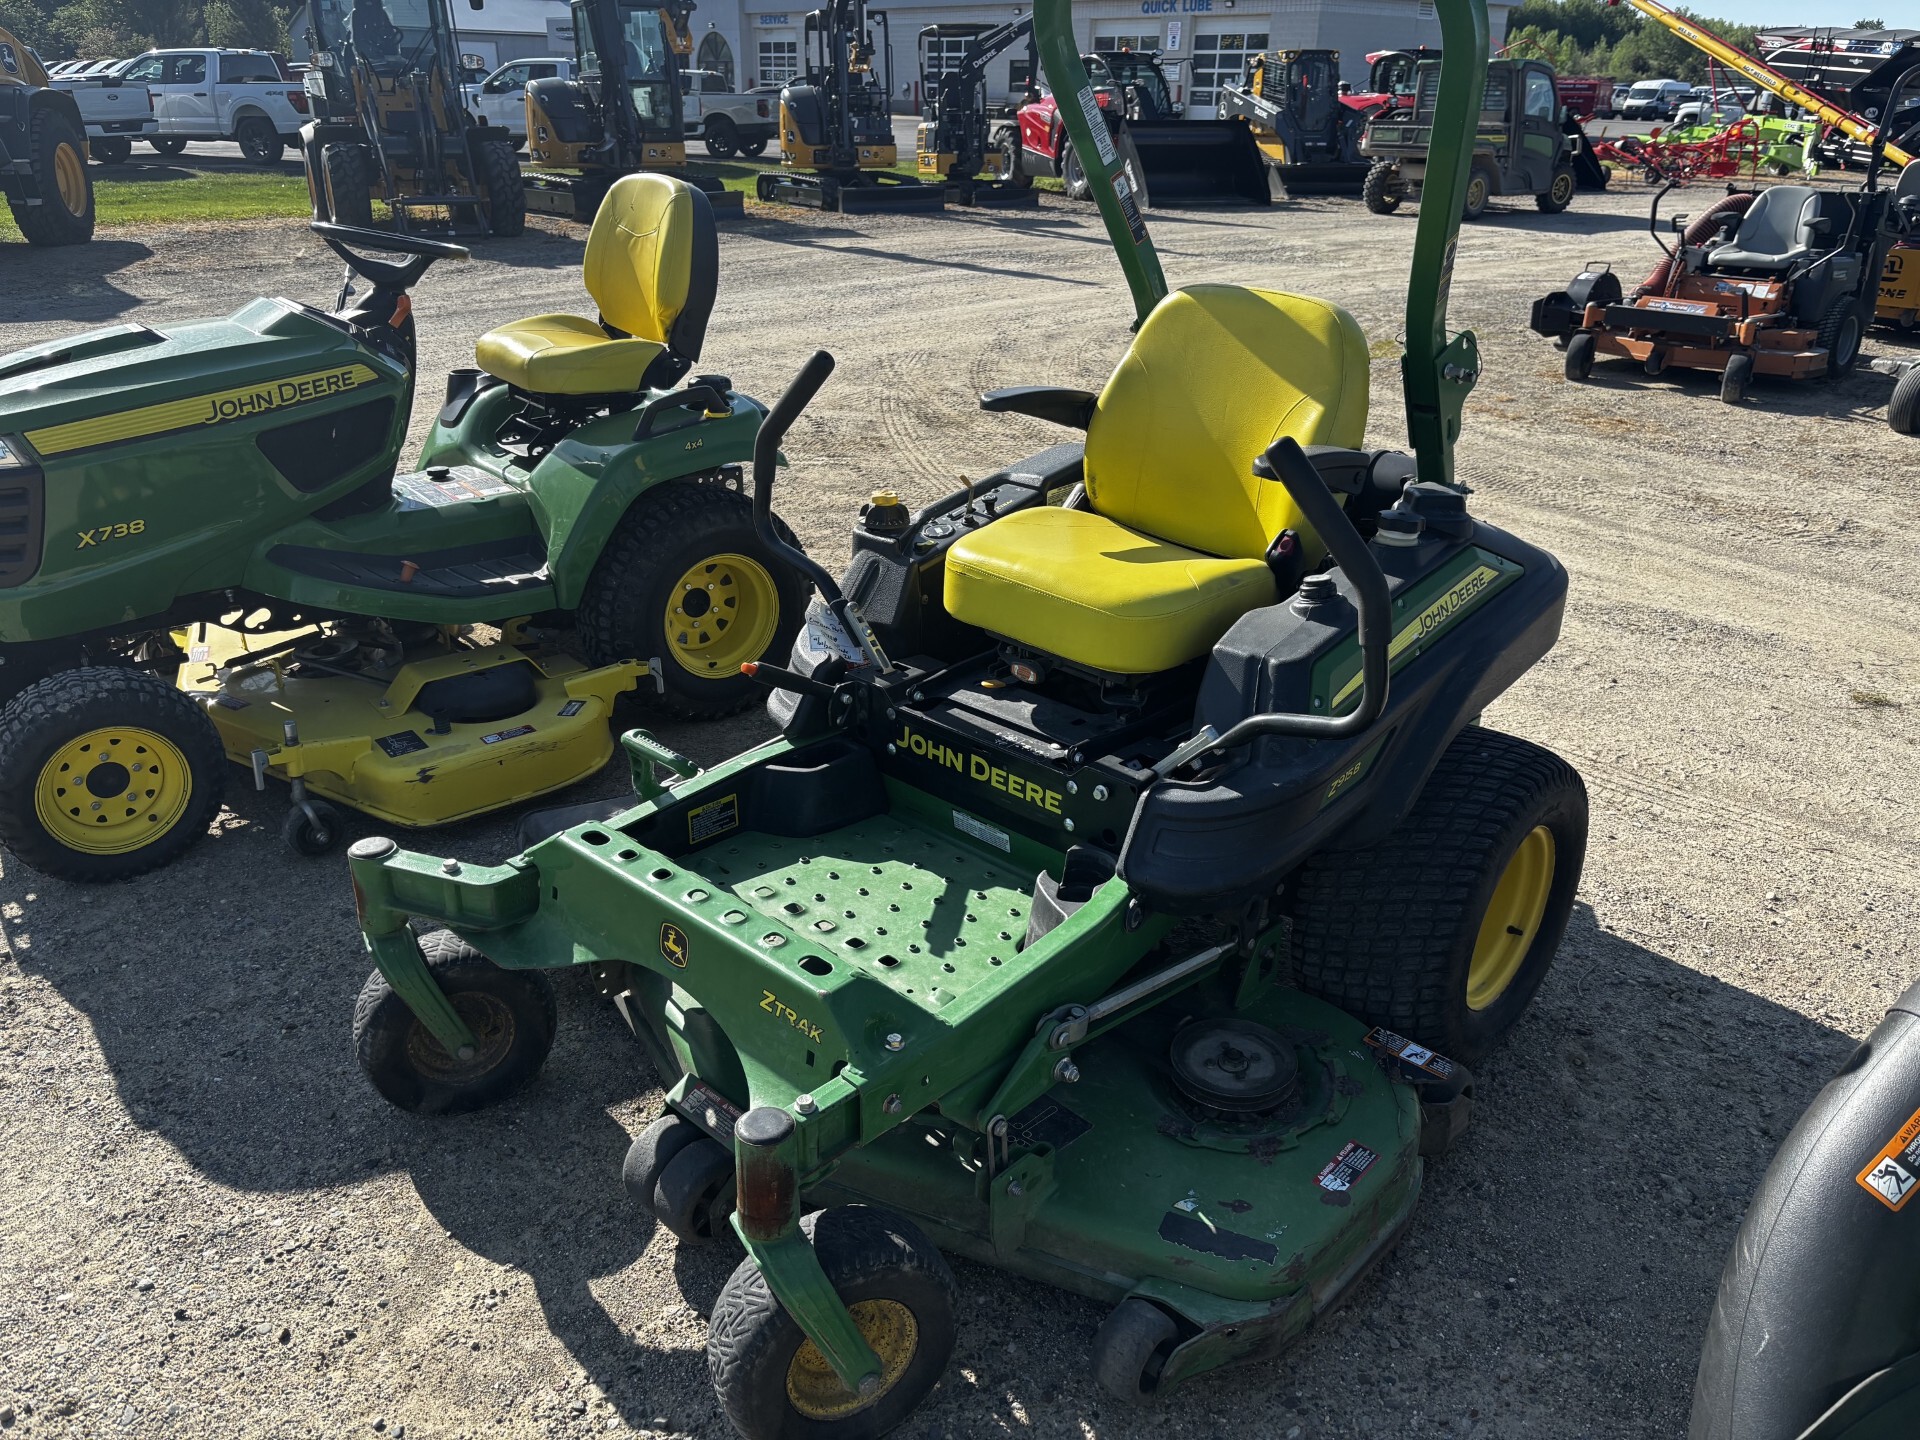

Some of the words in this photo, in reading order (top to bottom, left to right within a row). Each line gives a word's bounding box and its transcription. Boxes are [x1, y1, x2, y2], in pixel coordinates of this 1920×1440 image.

[760, 14, 788, 24] SERVICE
[1142, 0, 1177, 13] QUICK
[1183, 0, 1212, 12] LUBE
[973, 48, 997, 68] DEERE
[1753, 70, 1777, 86] WESTFIELD
[205, 389, 273, 423] JOHN
[278, 370, 356, 404] DEERE
[76, 519, 146, 550] X738
[1417, 600, 1449, 636] JOHN
[1450, 572, 1487, 609] DEERE
[896, 725, 963, 773] JOHN
[970, 754, 1063, 815] DEERE
[759, 989, 825, 1044] ZTRAK
[1907, 1115, 1920, 1136] WAR
